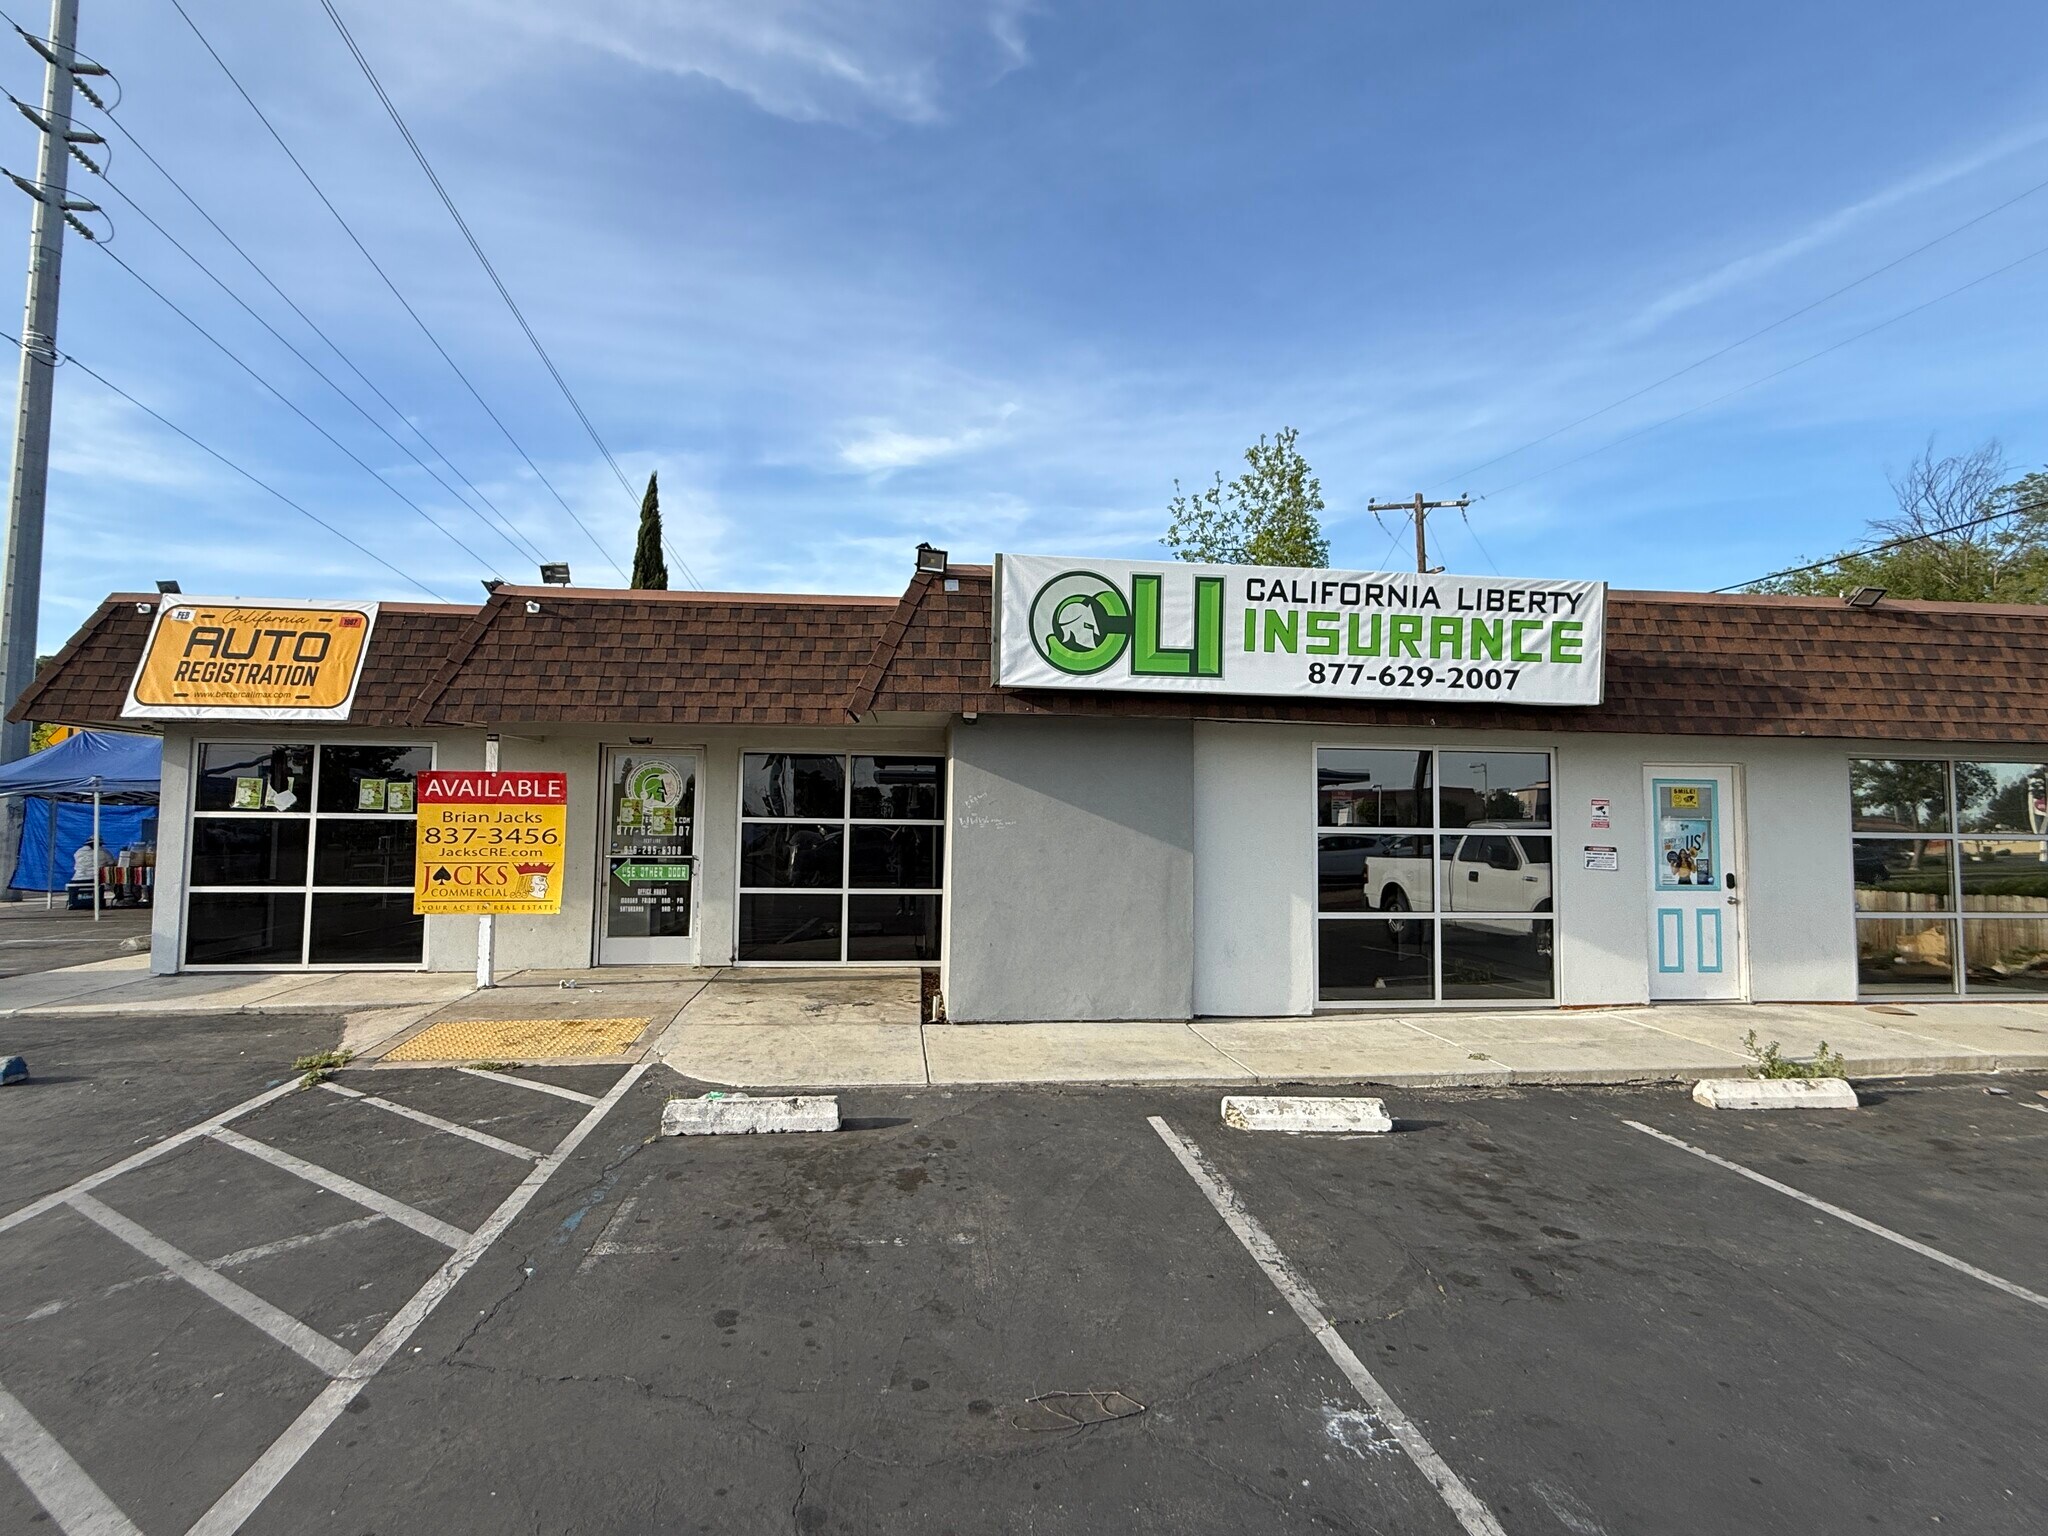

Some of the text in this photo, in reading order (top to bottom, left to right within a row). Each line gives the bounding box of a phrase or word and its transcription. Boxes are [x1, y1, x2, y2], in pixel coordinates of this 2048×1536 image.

[1245, 577, 1585, 615] CALIFORNIA LIBERTY
[176, 611, 191, 620] FEB
[221, 608, 311, 629] California
[182, 626, 332, 664] AUTO
[1243, 608, 1584, 664] INSURANCE
[173, 660, 320, 687] REGISTRATION
[1307, 662, 1521, 691] 877-629-2007
[193, 690, 292, 700] www.bettercallmax.com
[424, 779, 562, 798] AVAILABLE
[442, 811, 543, 824] Brian Jacks
[424, 827, 558, 845] 837-3456
[439, 847, 544, 857] JacksCRE.com
[621, 866, 686, 878] USE OTHER DOOR
[430, 888, 509, 898] COMMERCIAL
